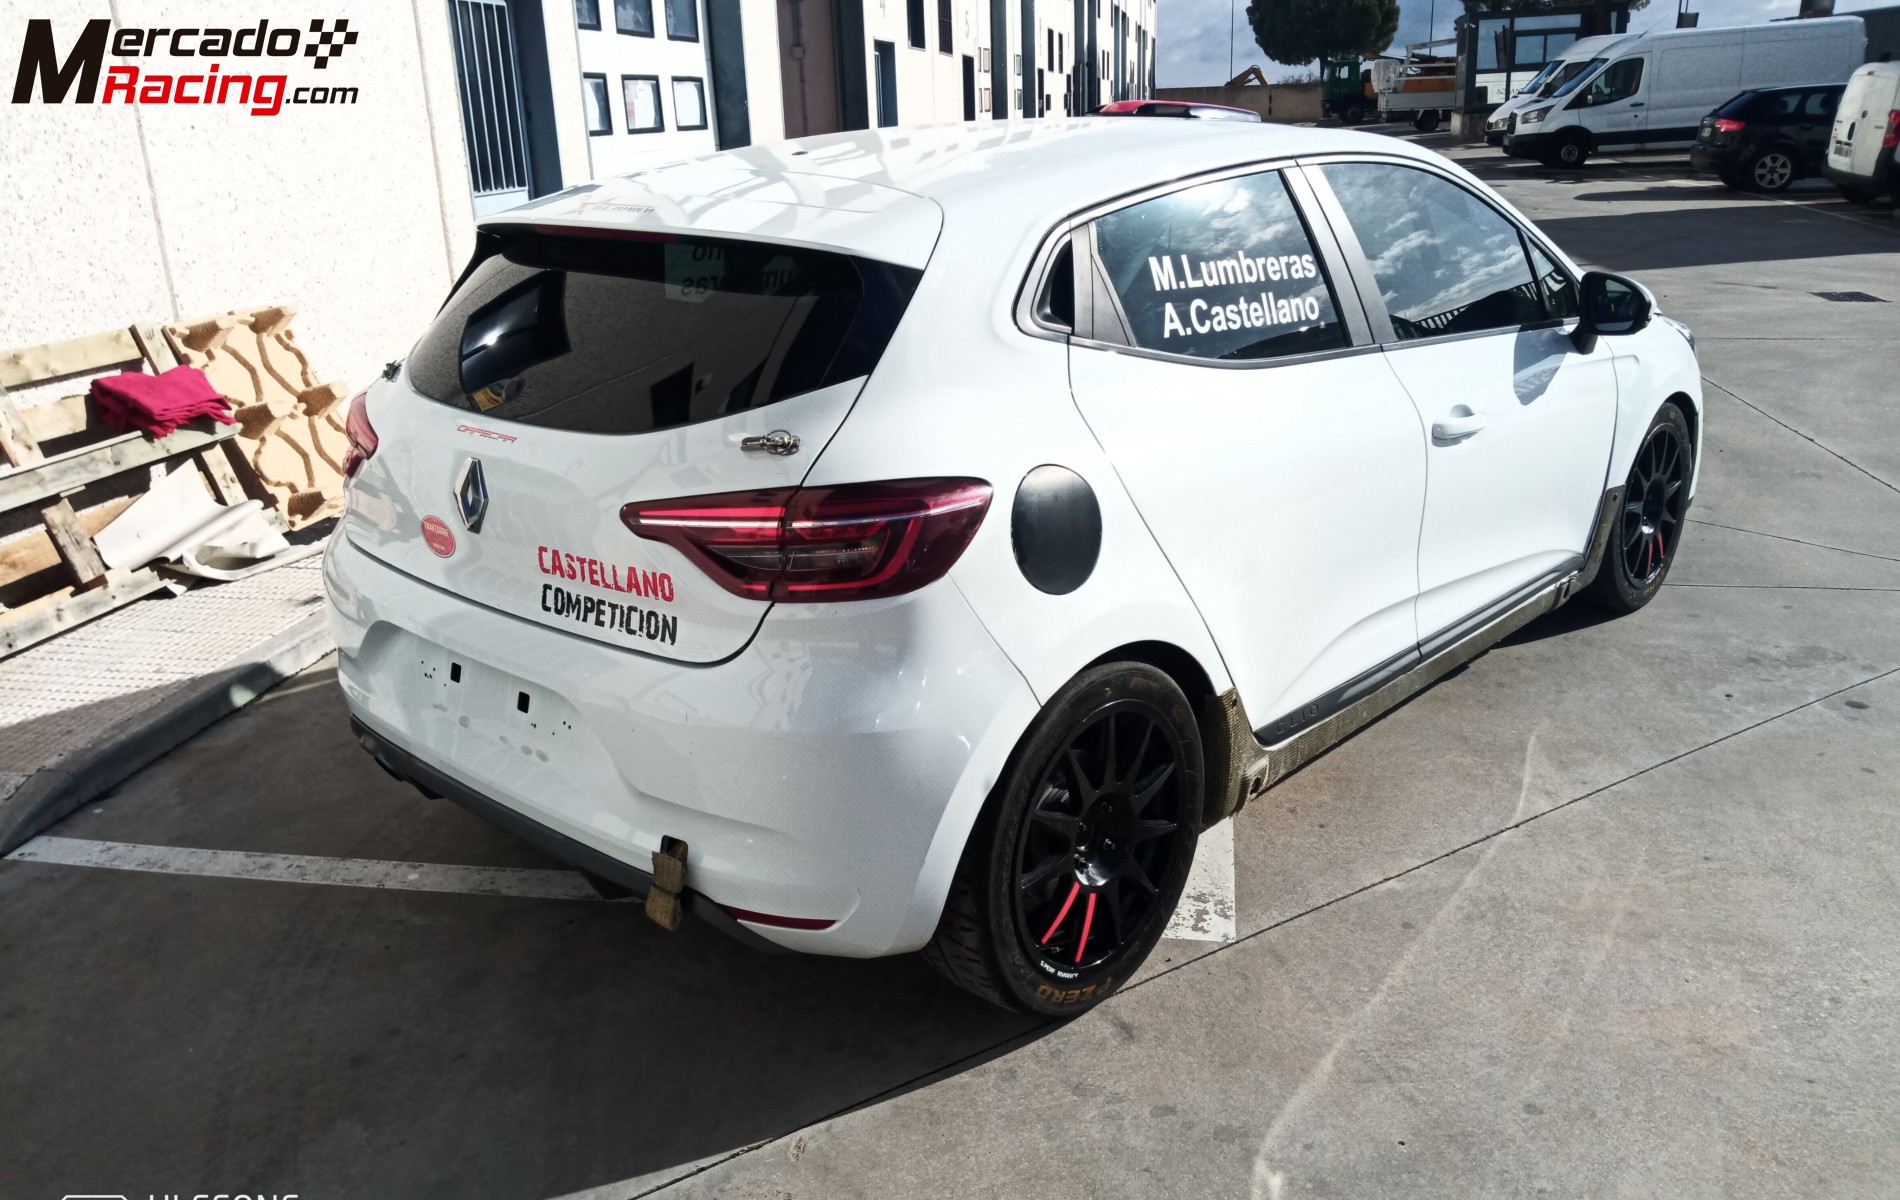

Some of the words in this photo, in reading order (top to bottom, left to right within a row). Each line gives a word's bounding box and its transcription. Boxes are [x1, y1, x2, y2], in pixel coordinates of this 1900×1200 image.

[1148, 250, 1316, 292] M.Lumbreras
[1163, 292, 1320, 338] A.Castellano
[537, 545, 675, 602] CASTELLANO
[541, 583, 678, 646] COMPETICION
[1276, 703, 1319, 734] CLIO
[1036, 983, 1097, 1004] ZERO
